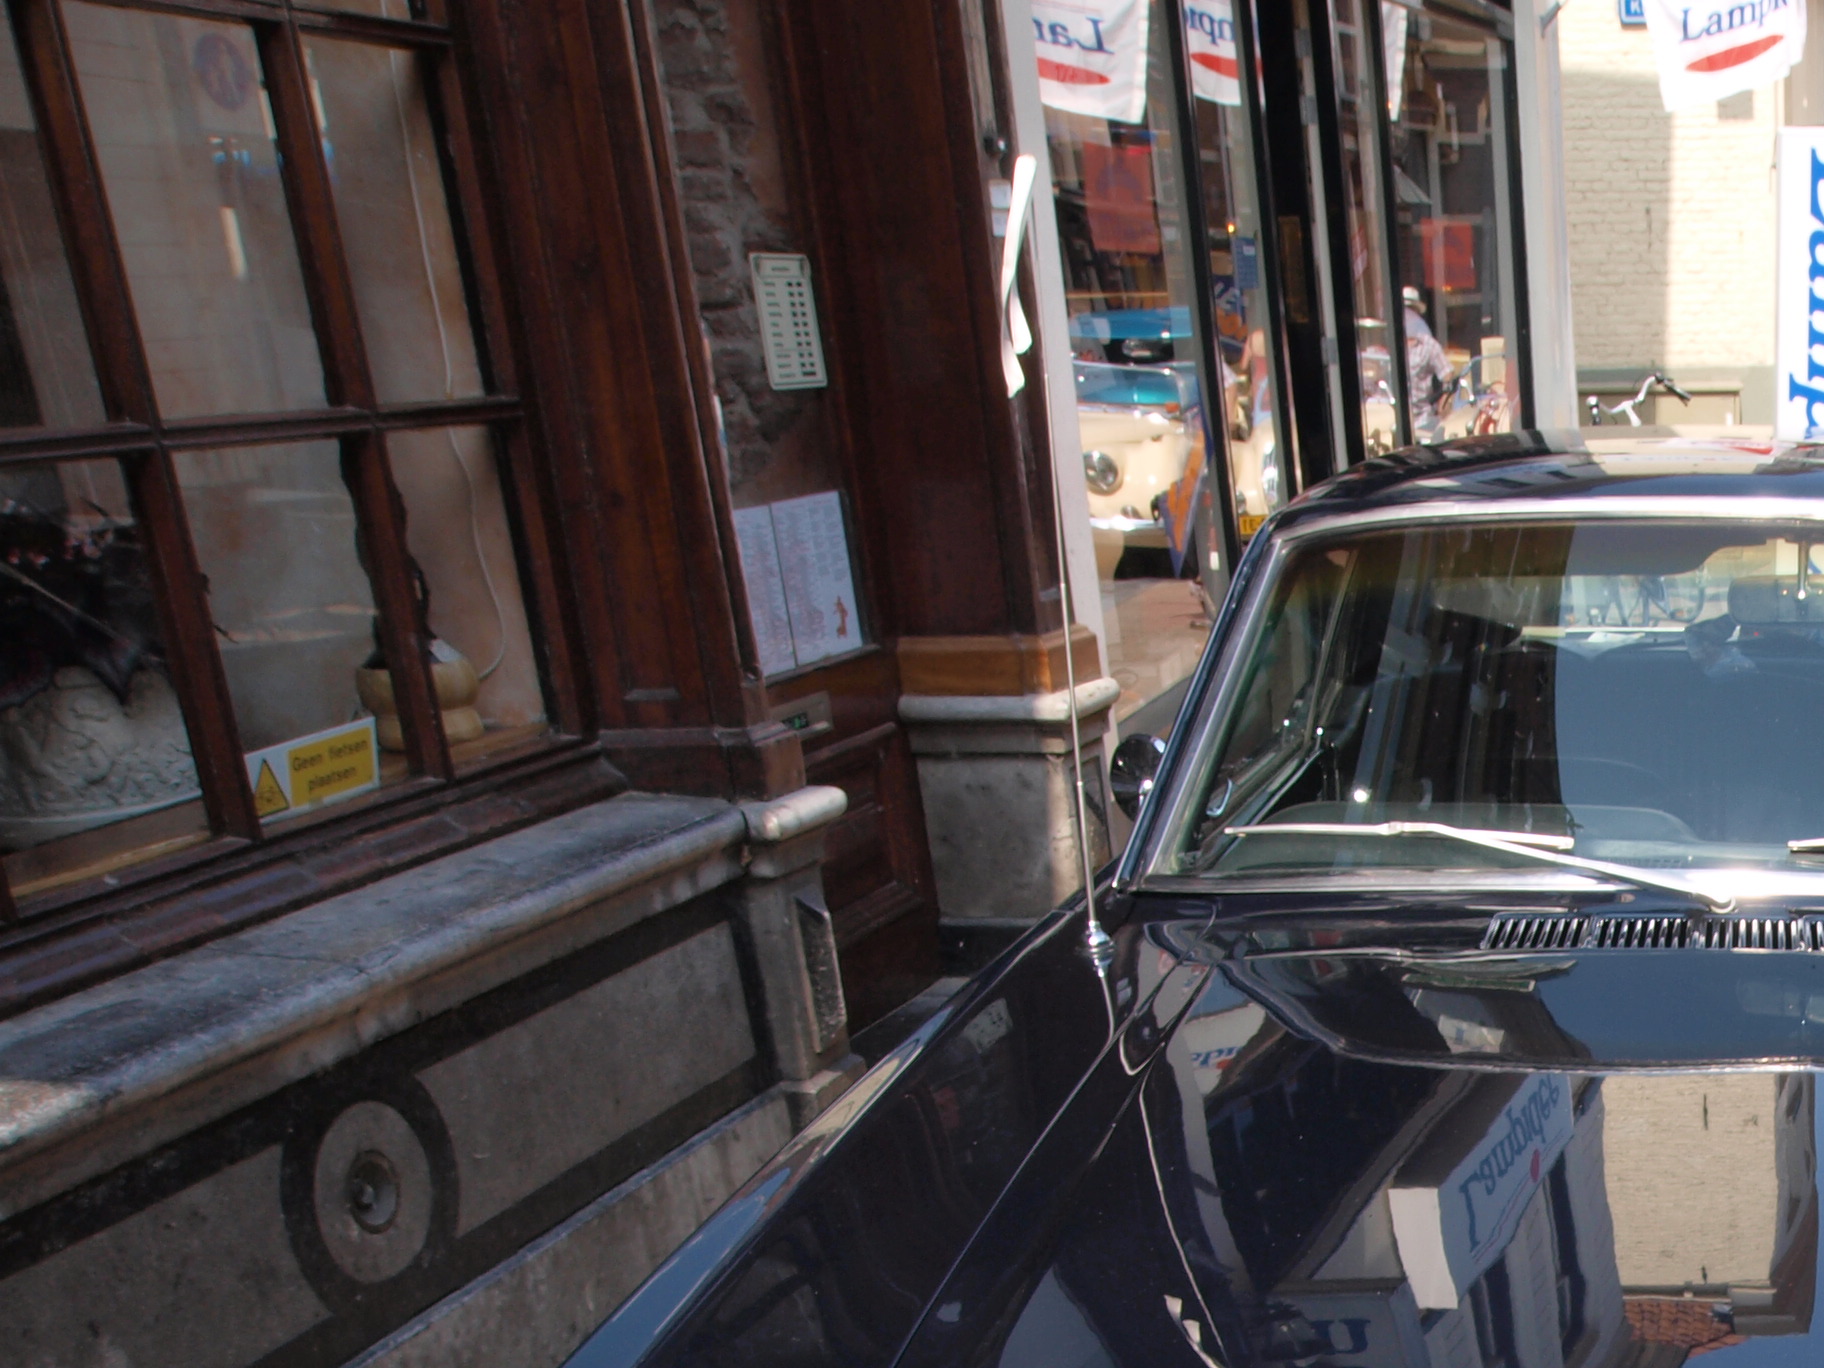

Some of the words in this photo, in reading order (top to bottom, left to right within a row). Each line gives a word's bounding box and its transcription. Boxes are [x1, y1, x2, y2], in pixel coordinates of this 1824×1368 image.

[1680, 0, 1787, 42] Lamp
[293, 754, 322, 771] Geen
[308, 767, 356, 792] plaatsen
